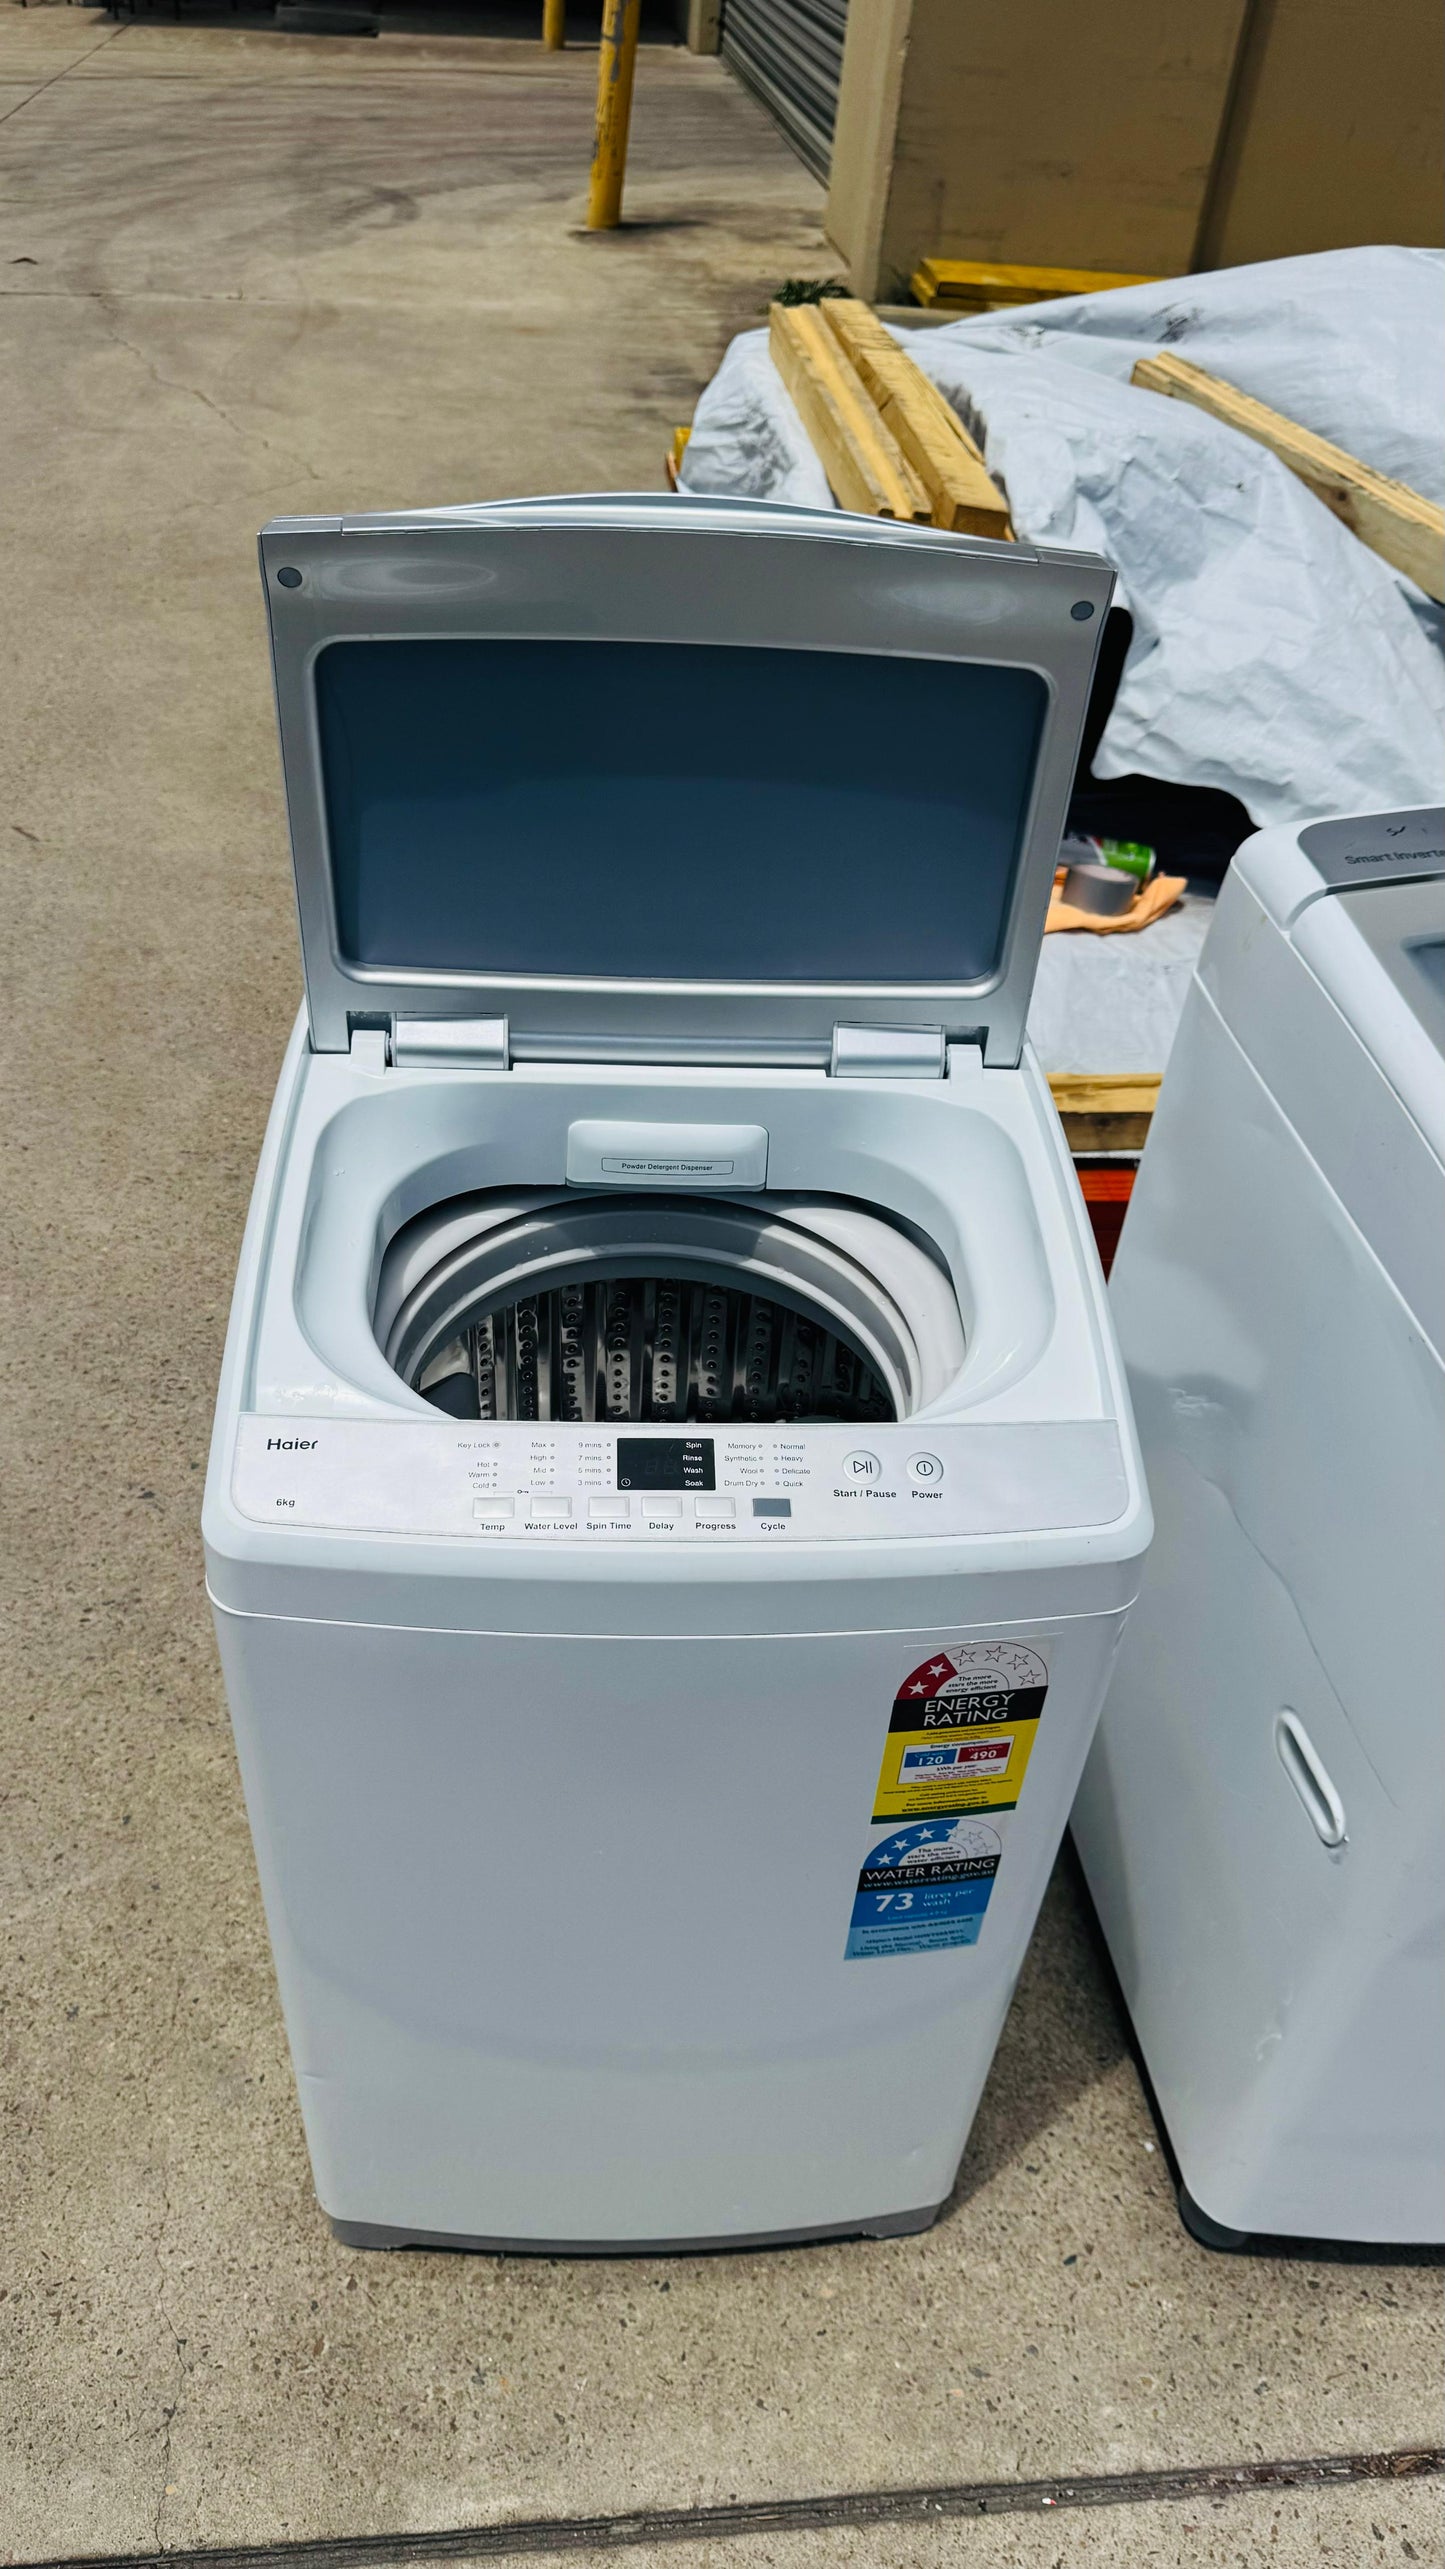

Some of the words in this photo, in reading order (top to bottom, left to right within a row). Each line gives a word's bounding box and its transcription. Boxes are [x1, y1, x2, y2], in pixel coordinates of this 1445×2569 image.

[1345, 853, 1393, 864] Smart
[267, 1438, 319, 1450] Haier
[724, 1455, 757, 1463] Synthetic
[780, 1455, 804, 1463] Heavy
[745, 1480, 759, 1488] Dry
[833, 1489, 857, 1498] Start
[866, 1490, 897, 1498] Pause
[912, 1490, 943, 1499] Power
[276, 1498, 296, 1508] 6kg
[480, 1523, 506, 1531] Temp
[524, 1522, 551, 1530] Water
[553, 1522, 578, 1530] Level
[586, 1522, 608, 1531] Spin
[609, 1522, 632, 1530] Time
[649, 1522, 674, 1531] Delay
[695, 1522, 737, 1531] Progress
[760, 1522, 786, 1531] Cycle
[970, 1684, 997, 1692] efficient
[924, 1693, 1016, 1713] ENERGY
[923, 1707, 1009, 1727] RATING
[969, 1750, 997, 1760] 490
[918, 1756, 944, 1766] 120
[866, 1867, 929, 1881] WATER
[930, 1858, 996, 1875] RATING
[954, 1889, 975, 1898] per
[876, 1892, 914, 1912] 73
[922, 1899, 951, 1908] wash
